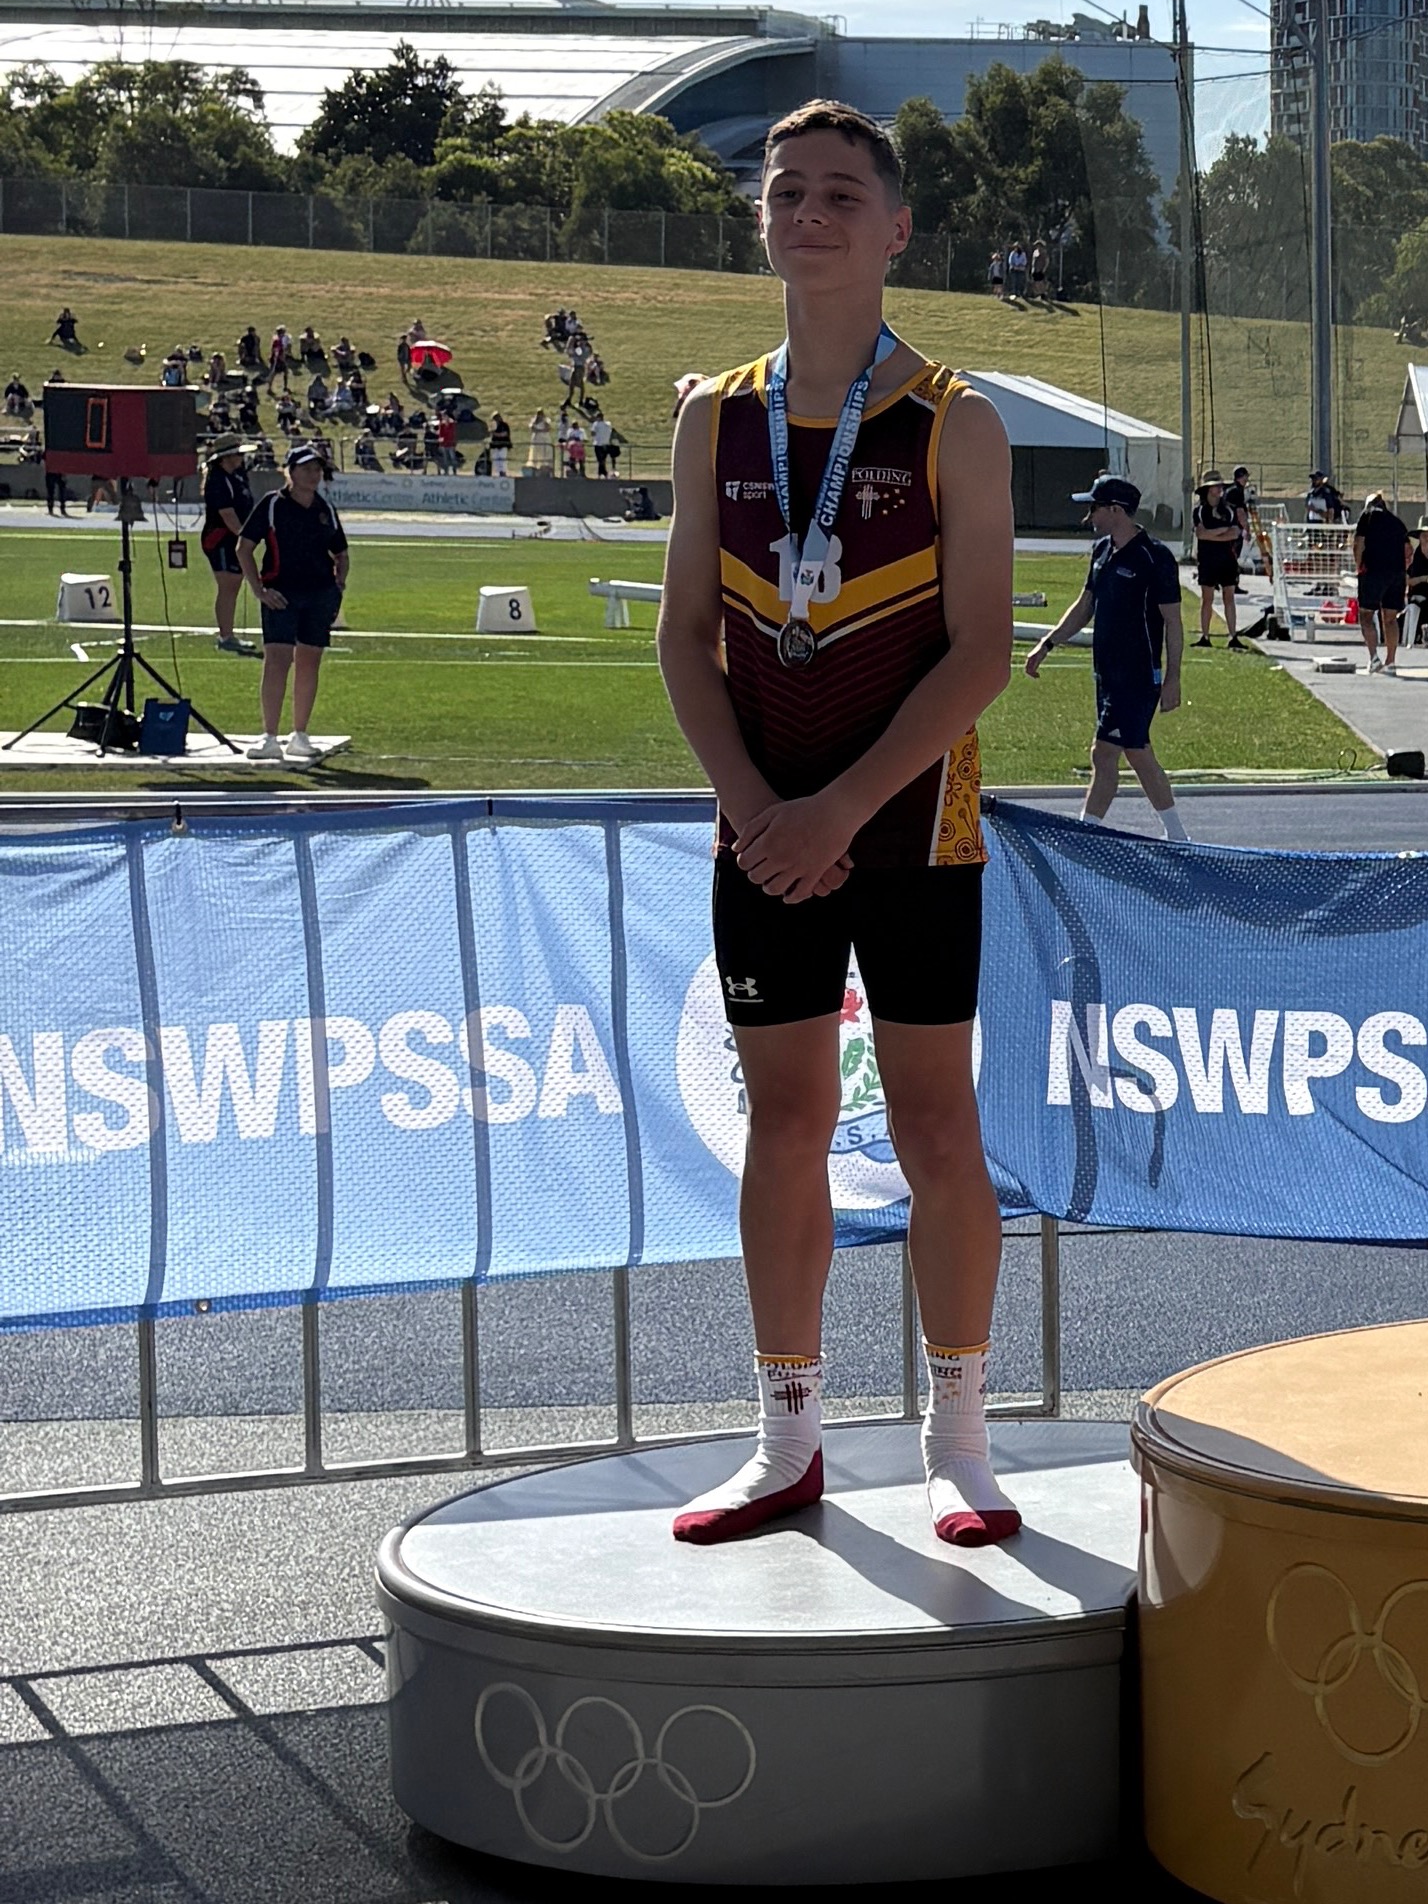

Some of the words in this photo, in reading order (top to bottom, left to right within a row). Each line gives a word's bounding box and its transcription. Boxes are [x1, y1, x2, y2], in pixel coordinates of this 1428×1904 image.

[820, 379, 869, 527] CHAMPIONSHIPS
[854, 469, 911, 485] POLDING
[422, 492, 468, 505] Athletic
[83, 586, 112, 609] 12
[507, 598, 522, 621] 8
[0, 1003, 625, 1154] NSWPSSA
